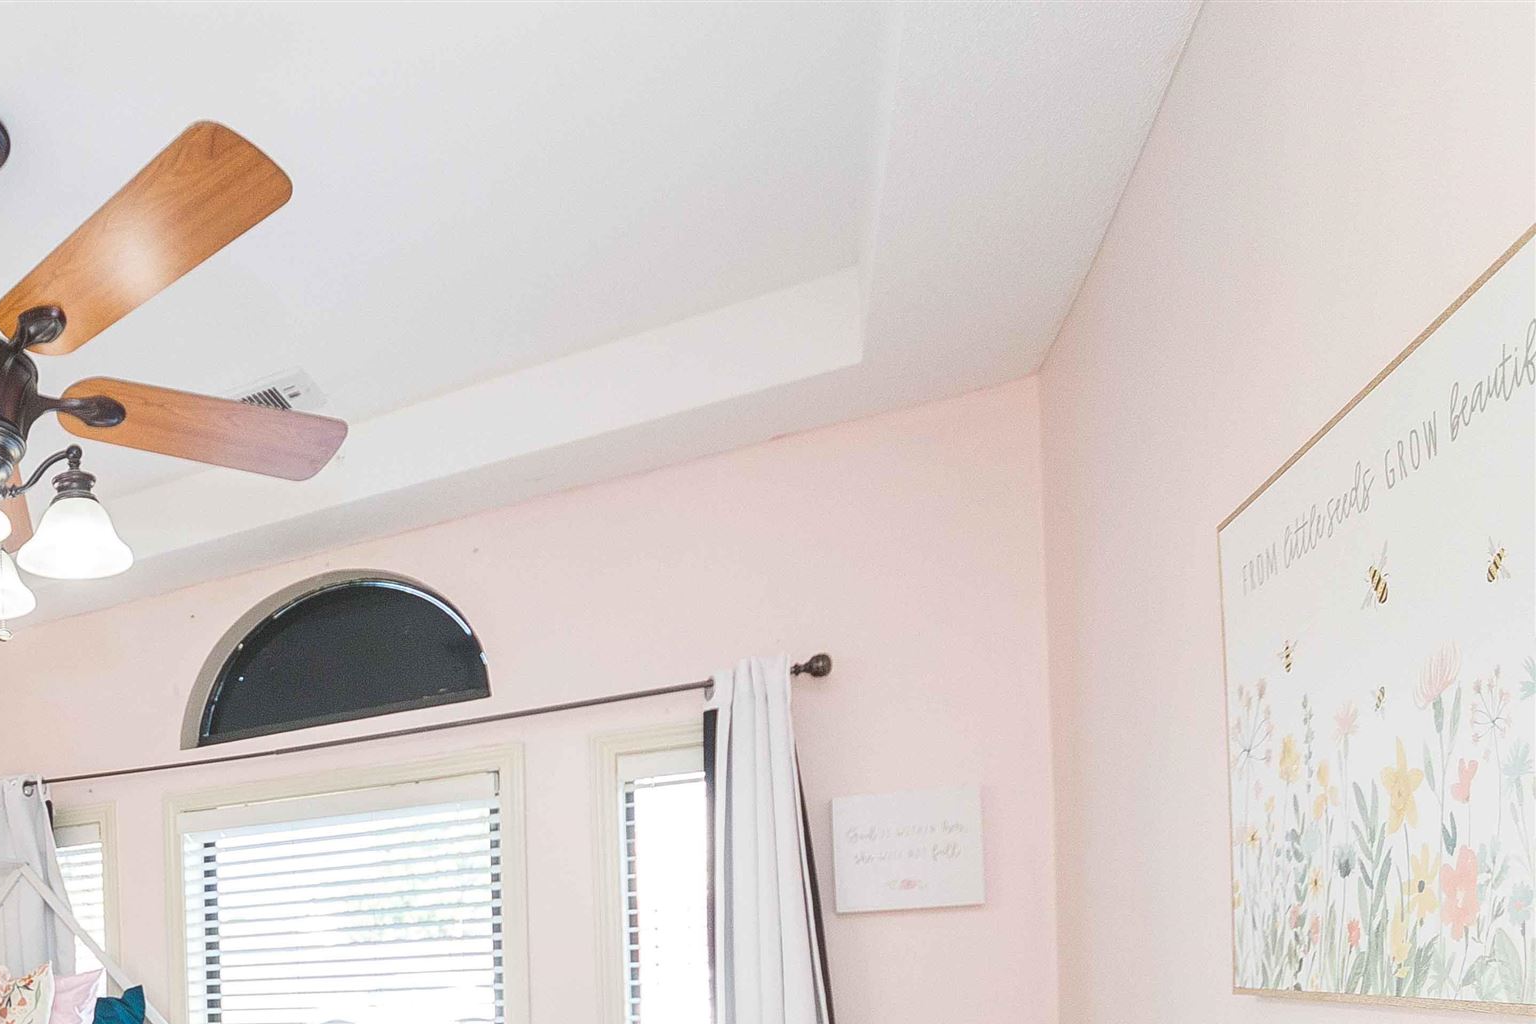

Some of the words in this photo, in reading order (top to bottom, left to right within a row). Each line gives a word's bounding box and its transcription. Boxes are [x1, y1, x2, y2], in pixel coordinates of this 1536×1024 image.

[1242, 542, 1279, 597] FROM
[1326, 460, 1376, 539] seeds
[1384, 411, 1439, 490] GROW
